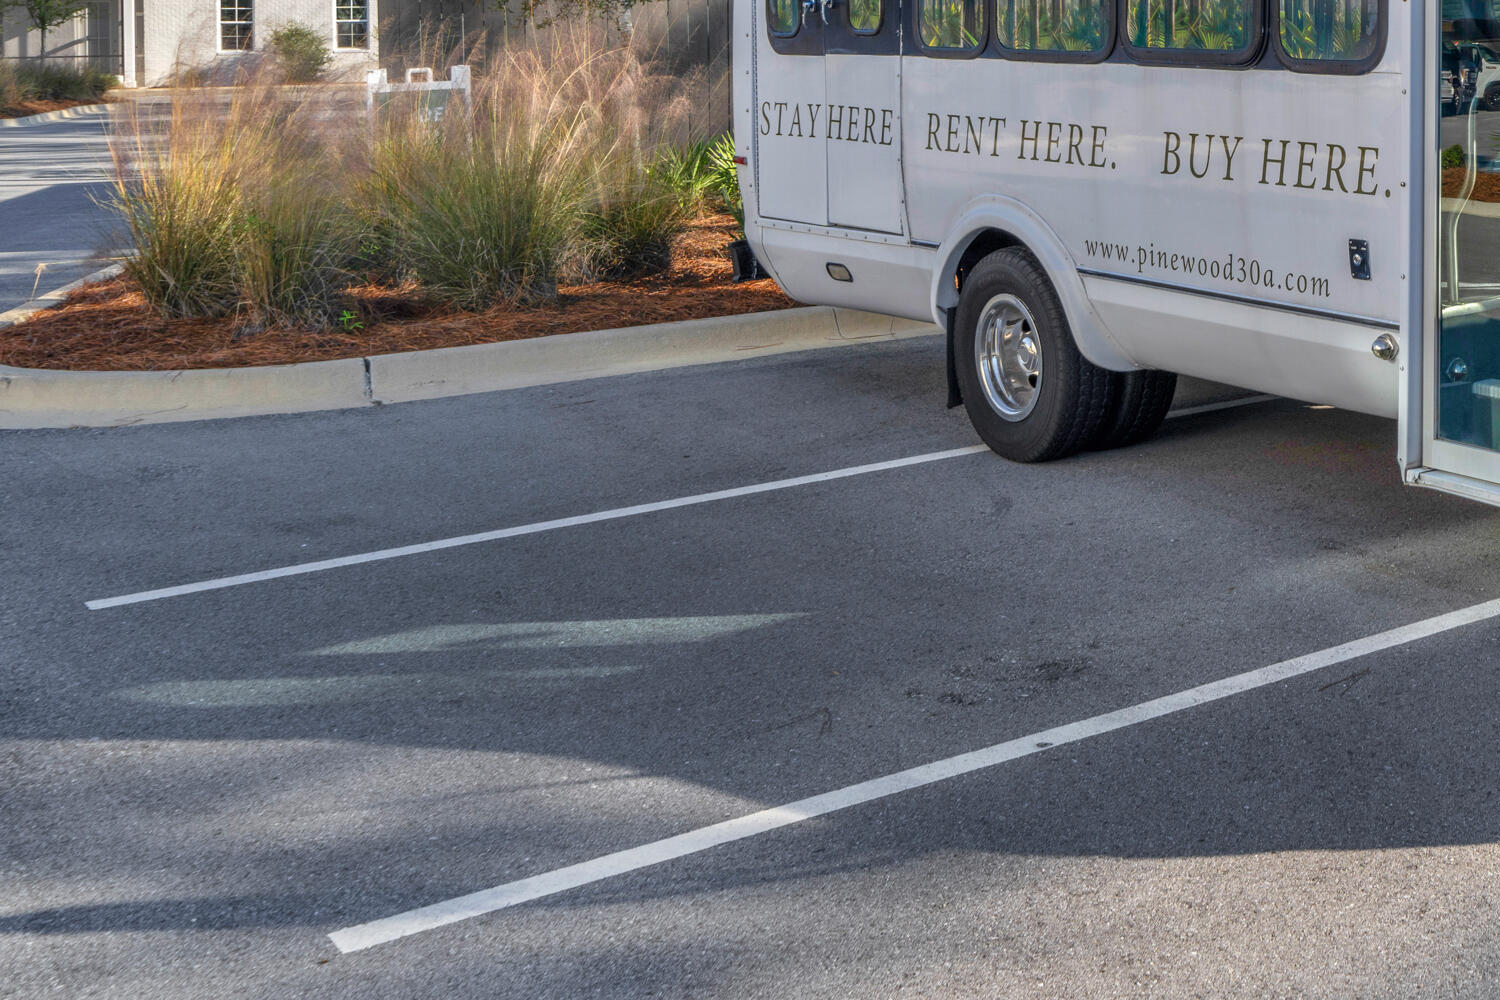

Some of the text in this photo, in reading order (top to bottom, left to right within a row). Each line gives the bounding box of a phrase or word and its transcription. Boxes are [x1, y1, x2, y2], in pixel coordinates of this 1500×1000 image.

[760, 101, 1391, 198] STAY HERE RENT HERE. BUY HERE.
[1085, 239, 1331, 297] www.pinewood30a.com
